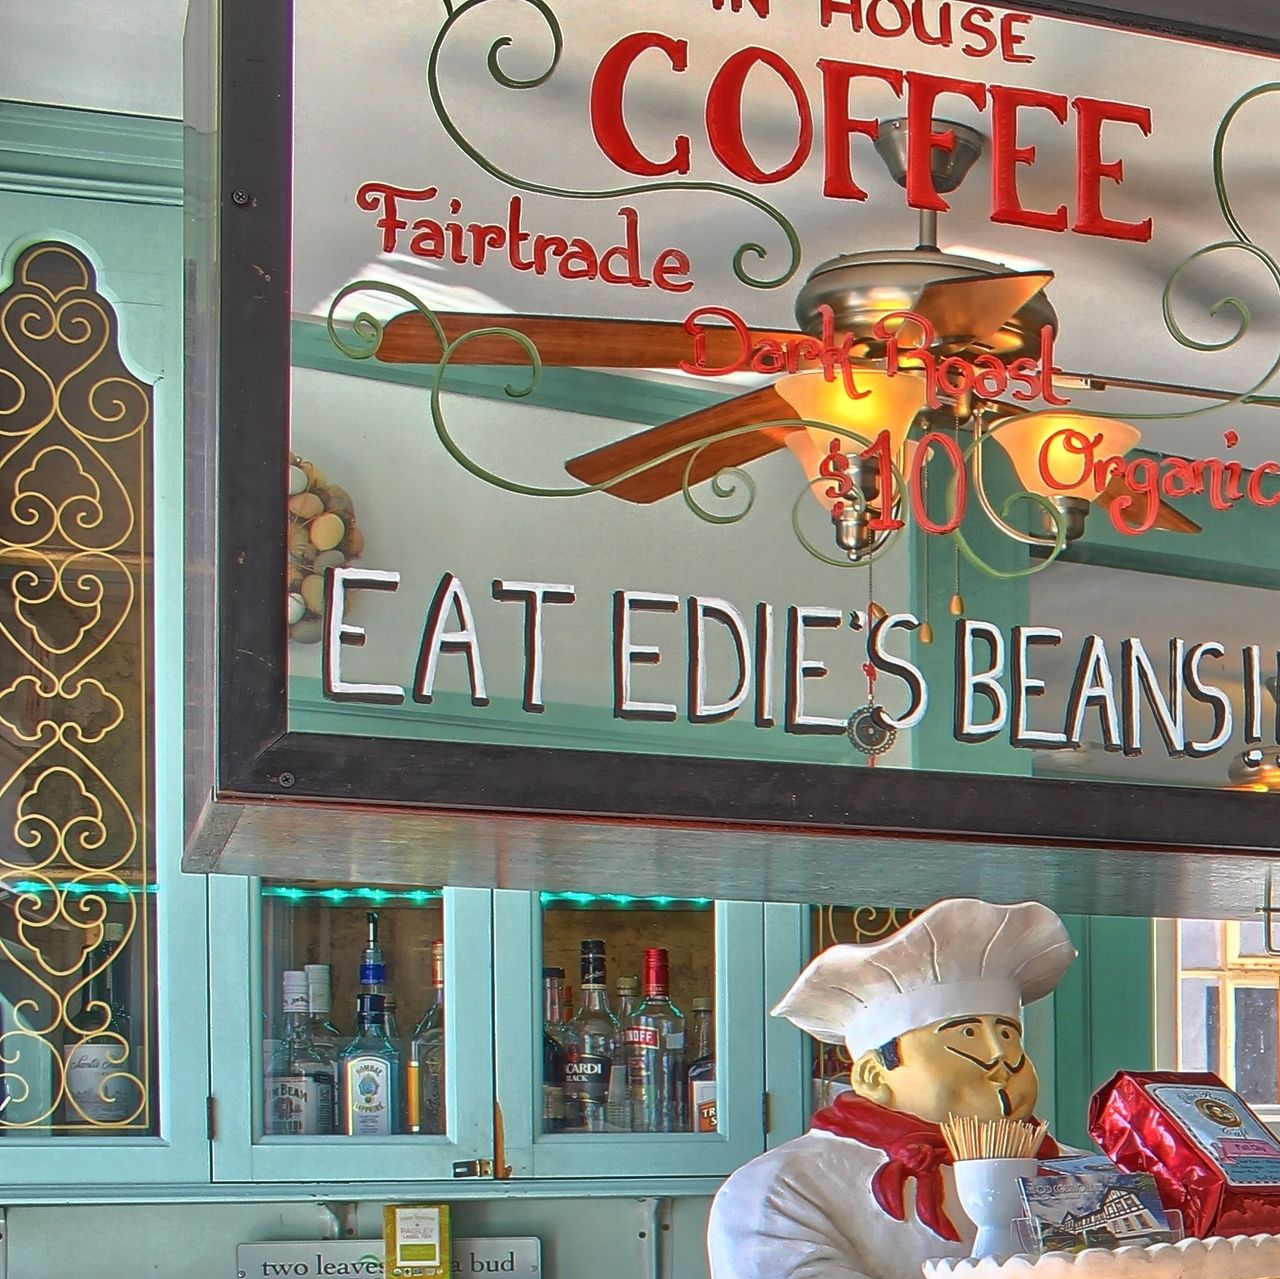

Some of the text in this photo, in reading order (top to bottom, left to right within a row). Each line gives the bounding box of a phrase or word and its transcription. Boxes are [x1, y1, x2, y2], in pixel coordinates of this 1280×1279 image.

[820, 0, 1034, 63] HOUSE
[589, 30, 1153, 243] COFFEE
[355, 181, 695, 294] Fairtrade
[679, 305, 1072, 408] Dark Roast
[817, 429, 968, 537] $10
[321, 565, 577, 714] EAT
[613, 591, 929, 737] EDIE'S
[566, 1062, 602, 1074] CARDI
[628, 1031, 653, 1042] NOFF
[280, 1083, 308, 1103] BEAM
[262, 1261, 308, 1276] two
[470, 1250, 515, 1273] bud
